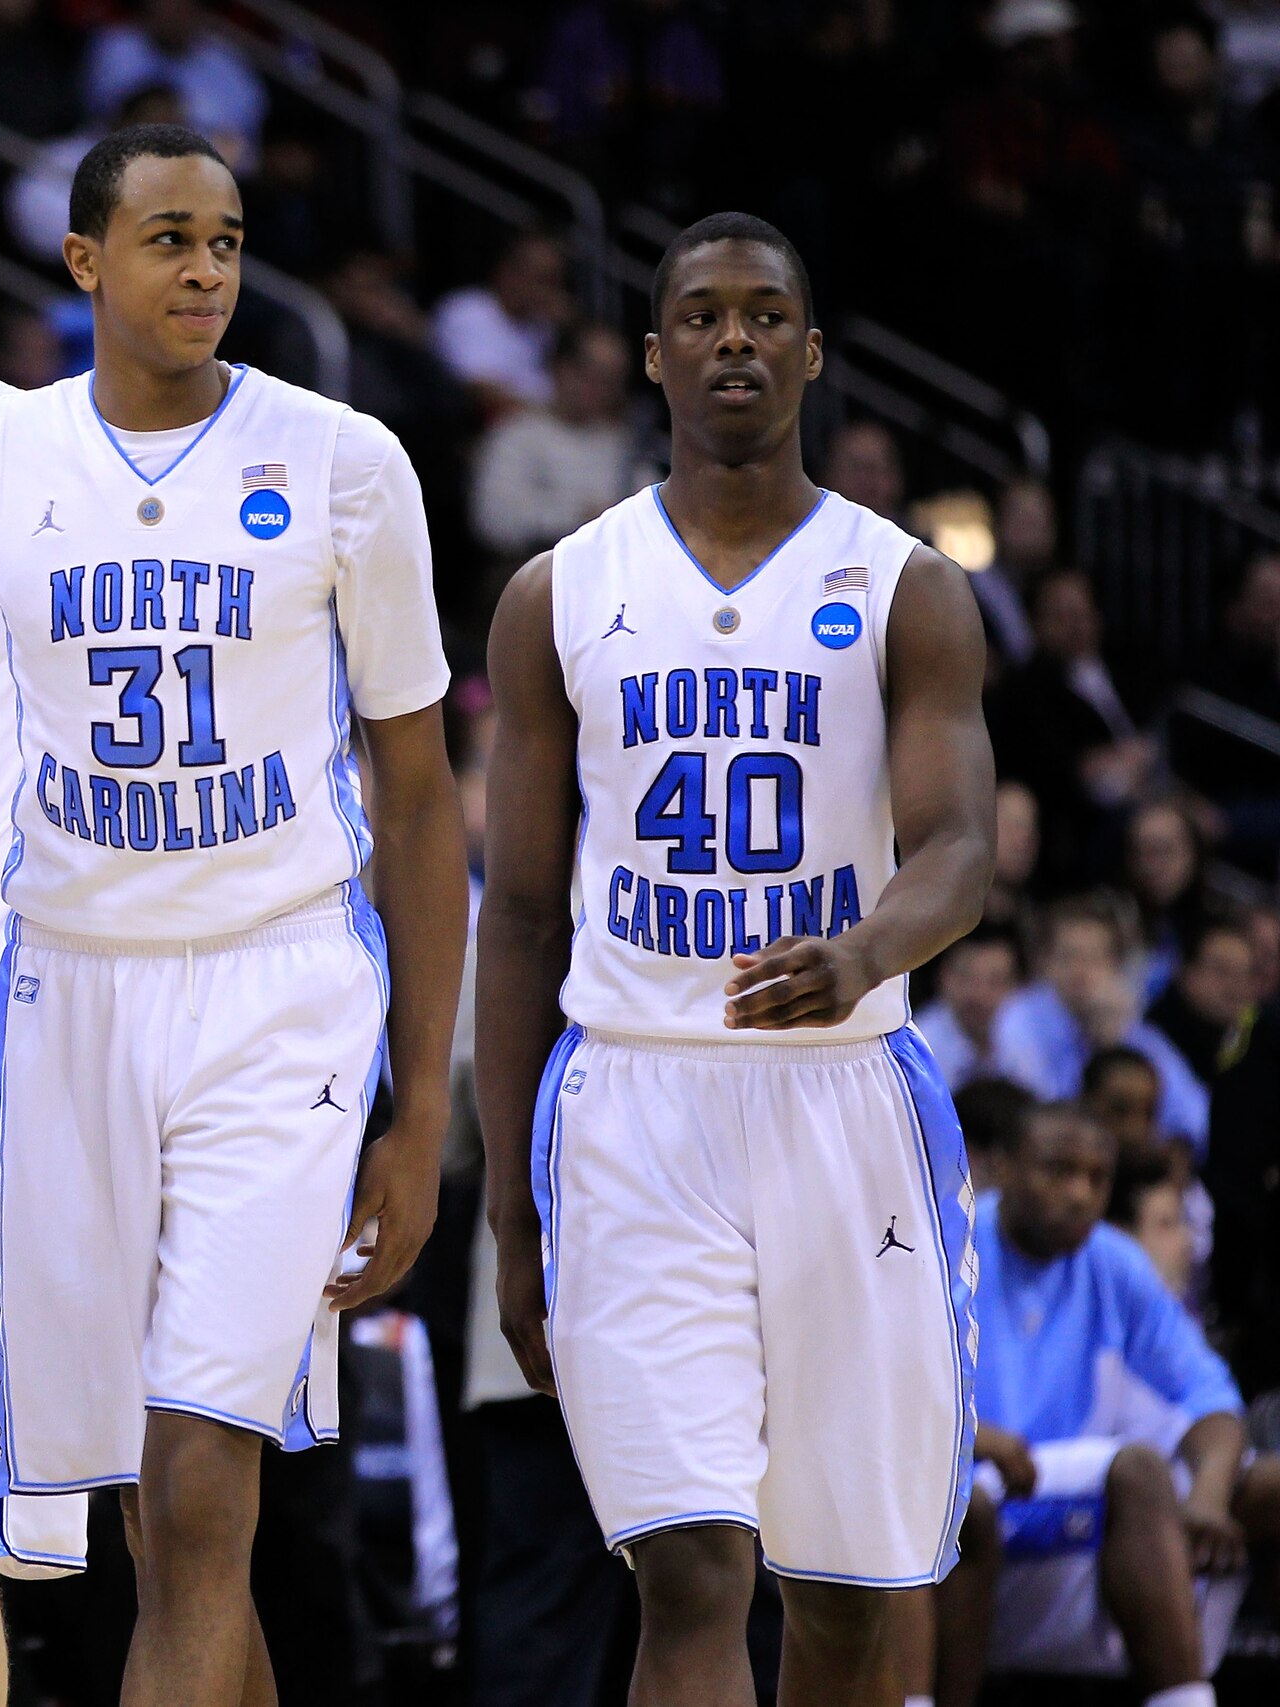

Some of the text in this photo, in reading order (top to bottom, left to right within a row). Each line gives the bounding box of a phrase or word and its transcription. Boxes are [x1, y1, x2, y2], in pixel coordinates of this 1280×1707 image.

[247, 511, 284, 527] NCAA
[50, 559, 254, 643] NORTH
[817, 623, 855, 637] NCAA
[87, 644, 226, 769] 31
[620, 668, 822, 749] NORTH
[37, 750, 296, 852] CAROLINA
[635, 751, 803, 874] 40
[607, 863, 863, 959] CAROLINA
